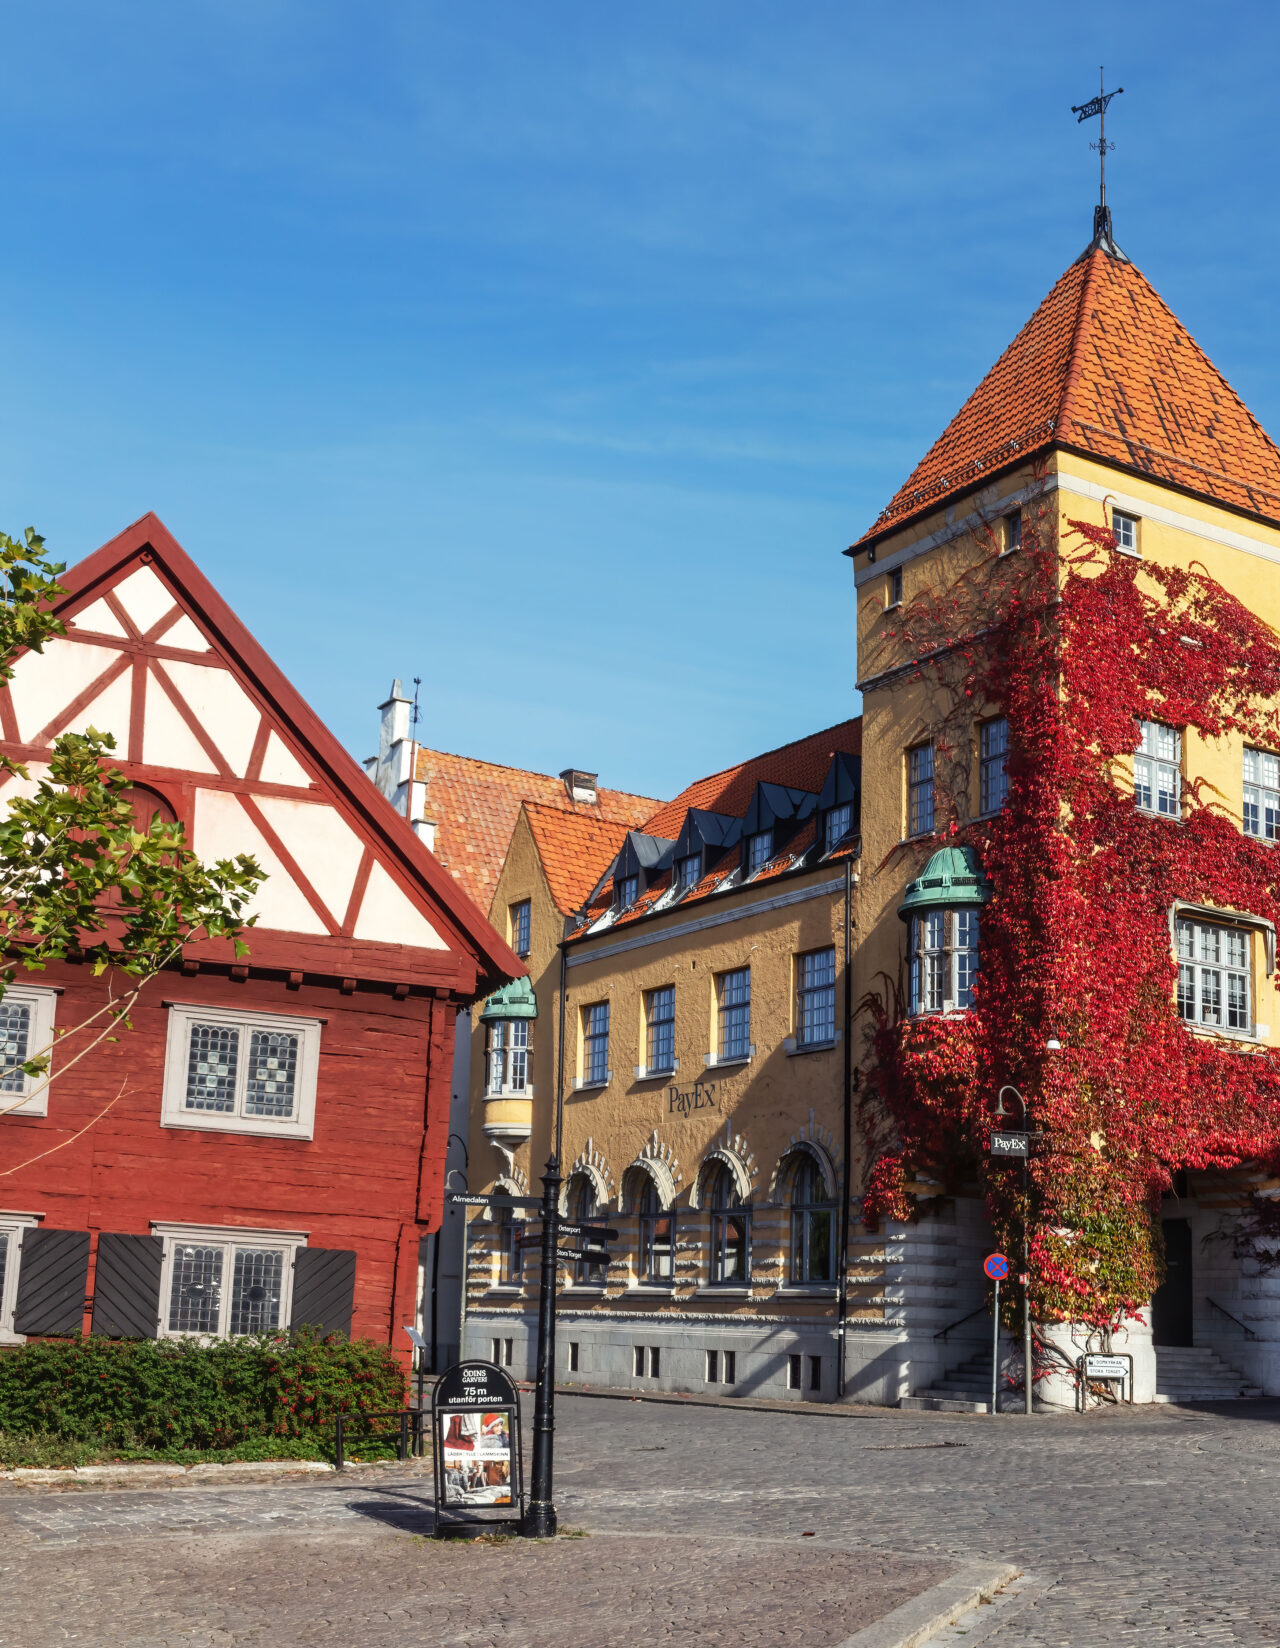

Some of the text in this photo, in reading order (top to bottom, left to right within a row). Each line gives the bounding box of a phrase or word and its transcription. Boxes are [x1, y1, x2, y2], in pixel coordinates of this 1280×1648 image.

[669, 1082, 716, 1119] PayEx
[994, 1137, 1026, 1151] PayEx
[452, 1195, 489, 1204] Almedalen
[558, 1225, 581, 1234] Österport
[556, 1249, 582, 1260] Stora Torget
[463, 1387, 476, 1396] 75
[448, 1396, 503, 1404] utanför porten
